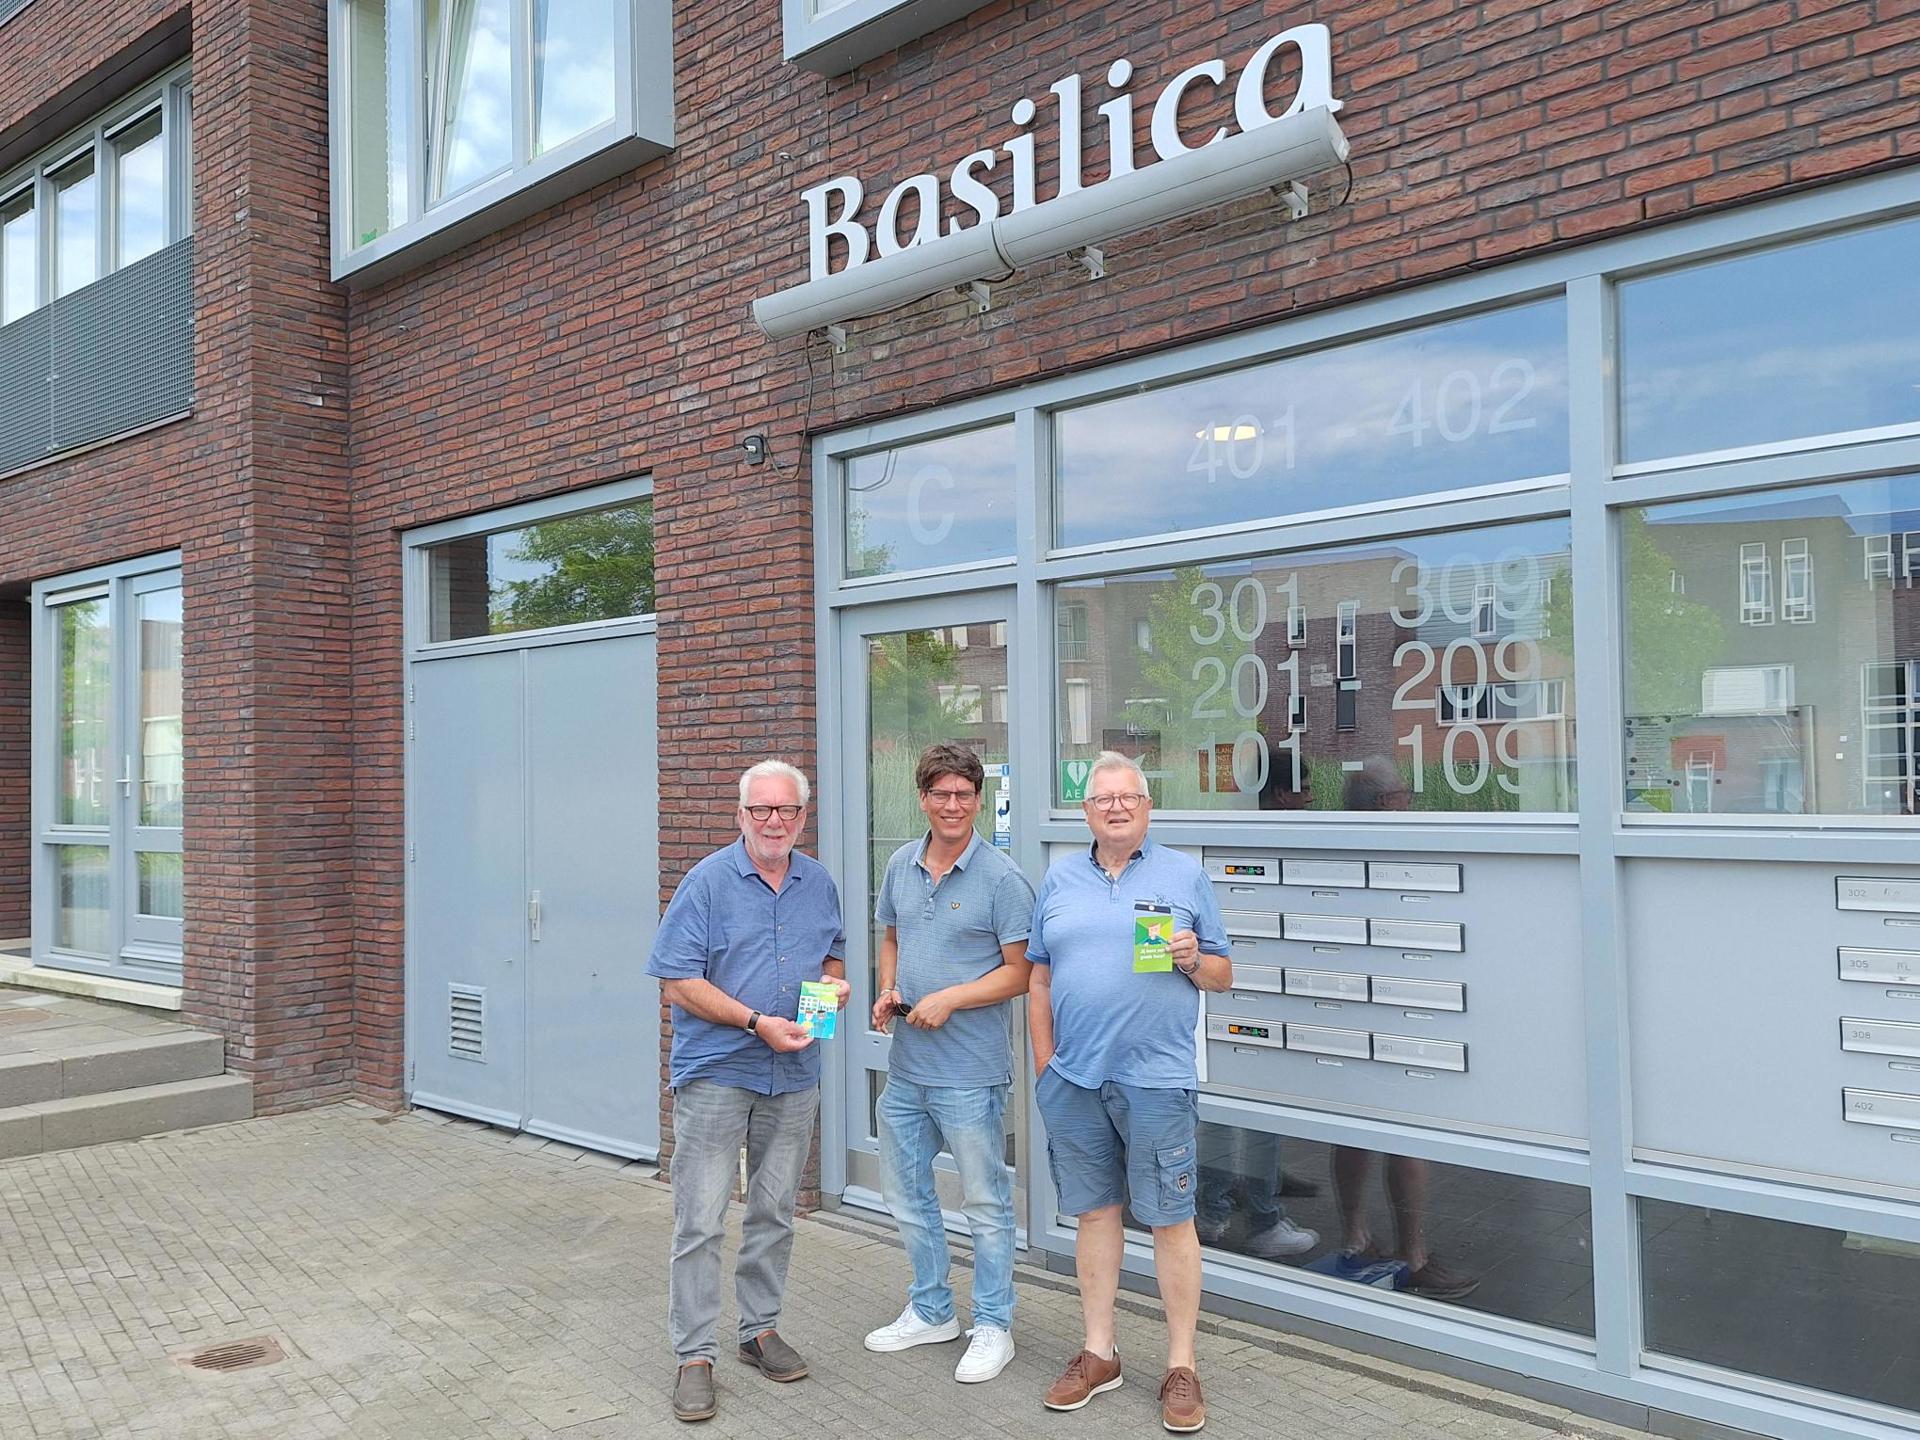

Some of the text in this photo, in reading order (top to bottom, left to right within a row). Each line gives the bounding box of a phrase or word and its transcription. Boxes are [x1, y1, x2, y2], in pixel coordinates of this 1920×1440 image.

[801, 23, 1343, 282] Basilica
[1187, 404, 1296, 483] 401
[1388, 358, 1537, 448] 402
[906, 464, 956, 546] C
[1190, 572, 1299, 645] 301
[1389, 547, 1541, 628] 309
[1192, 650, 1299, 719] 201
[1392, 634, 1543, 711] 209
[1065, 789, 1086, 799] AE
[1198, 731, 1302, 794] 101
[1398, 720, 1542, 794] 109
[1847, 888, 1867, 897] 302
[1849, 960, 1870, 969] 305
[1851, 1030, 1871, 1040] 308
[1854, 1102, 1874, 1111] 402
